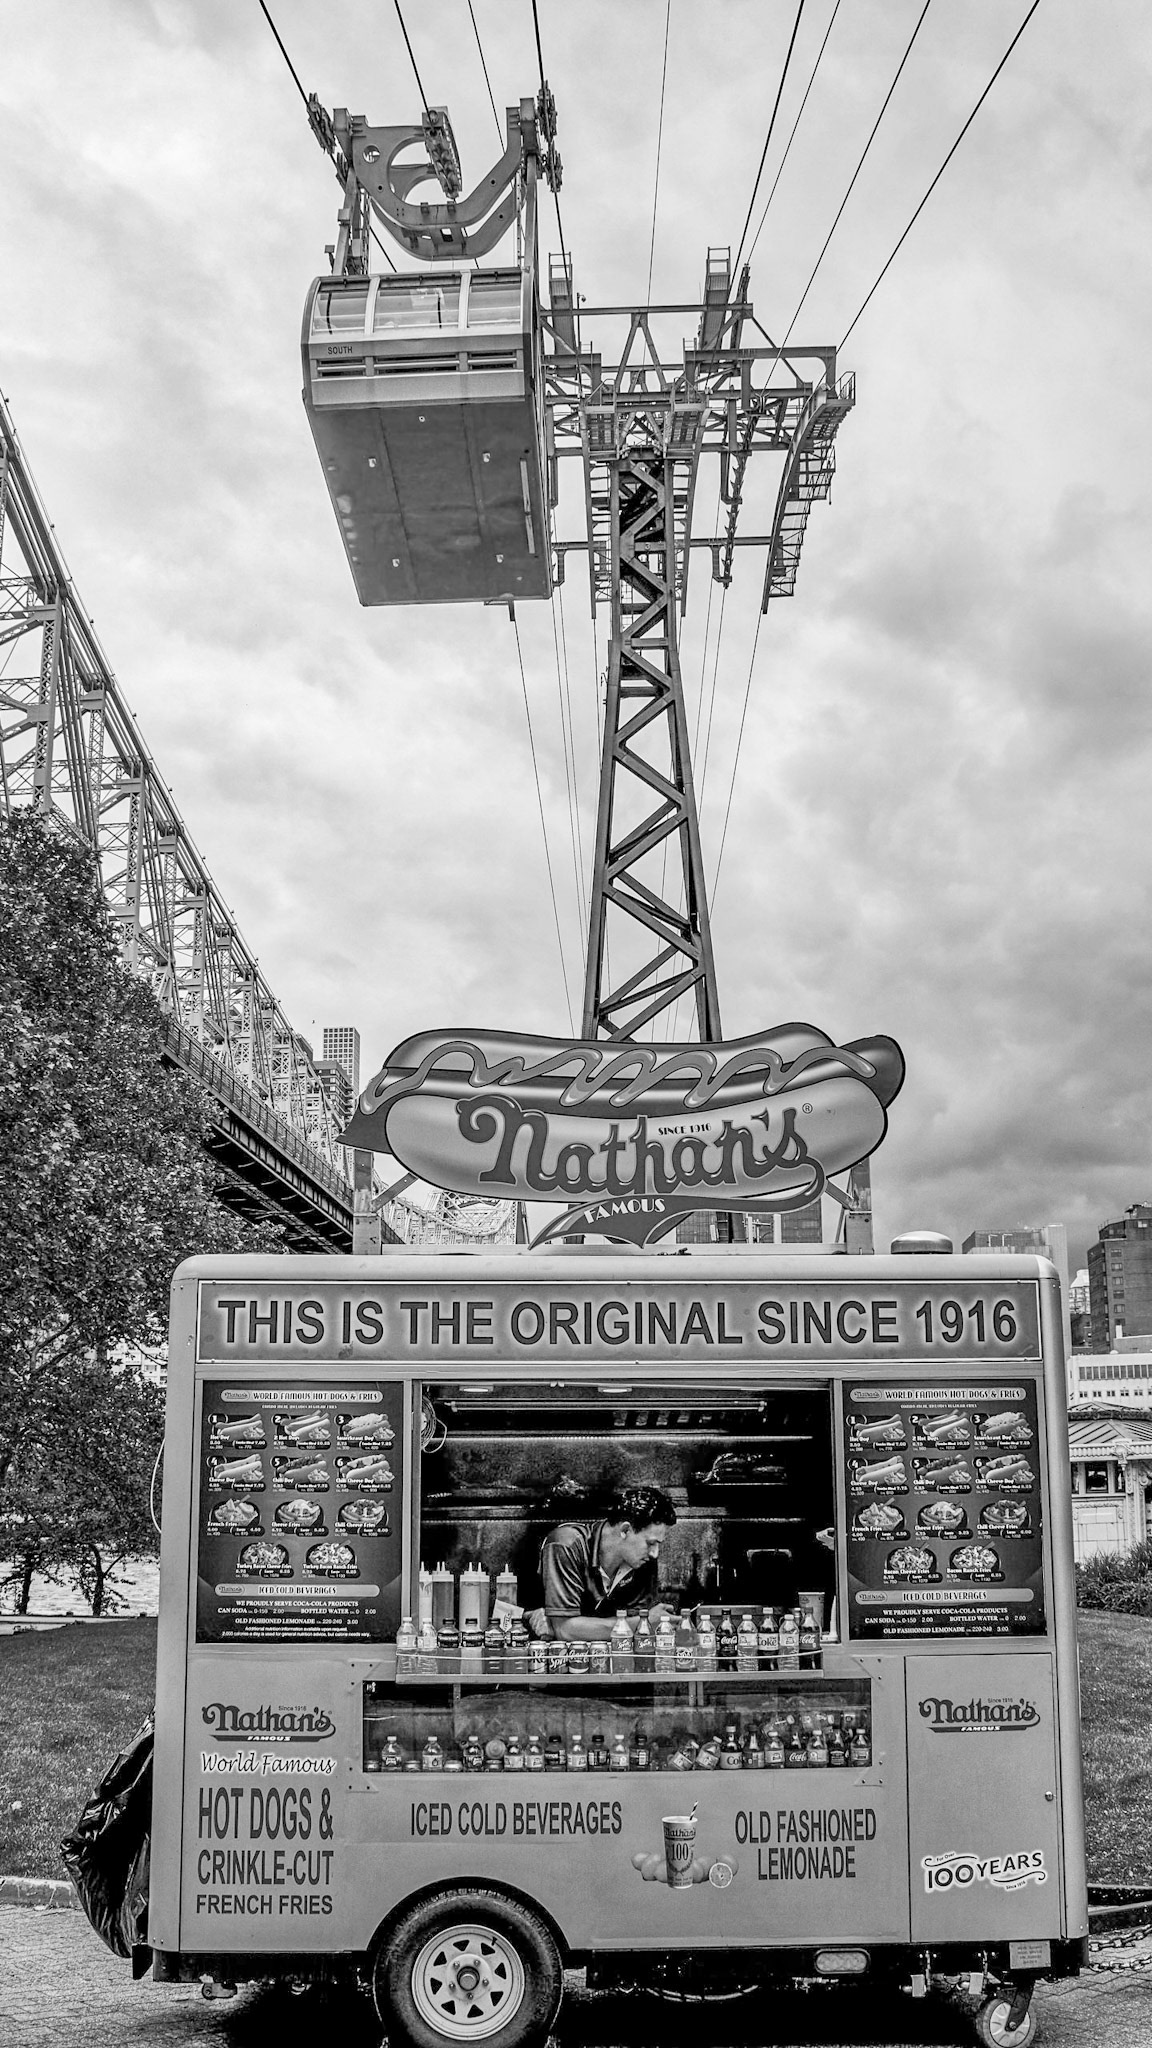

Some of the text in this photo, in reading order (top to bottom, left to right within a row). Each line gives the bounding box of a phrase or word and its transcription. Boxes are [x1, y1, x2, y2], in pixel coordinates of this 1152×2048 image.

[328, 346, 352, 355] SOUTH
[658, 1122, 712, 1136] SINCE 1916
[455, 1093, 825, 1196] Nathan's
[583, 1198, 666, 1224] FAMOUS
[218, 1300, 1017, 1344] THIS IS THE ORIGINAL SINCE 1916
[885, 1390, 1019, 1398] WORLD FAMOUS HOT DOGS & FRIES
[212, 1415, 218, 1423] 1
[275, 1415, 281, 1423] 2
[338, 1416, 344, 1424] 3
[851, 1416, 856, 1424] 1
[211, 1458, 218, 1466] 4
[274, 1458, 280, 1466] 5
[337, 1458, 343, 1466] 6
[852, 1460, 858, 1468] 4
[914, 1459, 920, 1467] 5
[903, 1592, 986, 1601] ICED COLD BEVERAGES
[202, 1703, 336, 1732] Nathan's
[919, 1698, 1040, 1724] Nathan's
[202, 1752, 335, 1775] World Famous
[199, 1787, 333, 1840] HOT DOGS &
[411, 1802, 622, 1835] ICED COLD BEVERAGES
[735, 1808, 876, 1843] OLD FASHIONED
[672, 1843, 688, 1860] 100
[197, 1850, 334, 1885] CRINKLE-CUT
[758, 1846, 856, 1880] LEMONADE
[928, 1852, 1042, 1888] 100 YEARS
[196, 1894, 333, 1914] FRENCH FRIES
